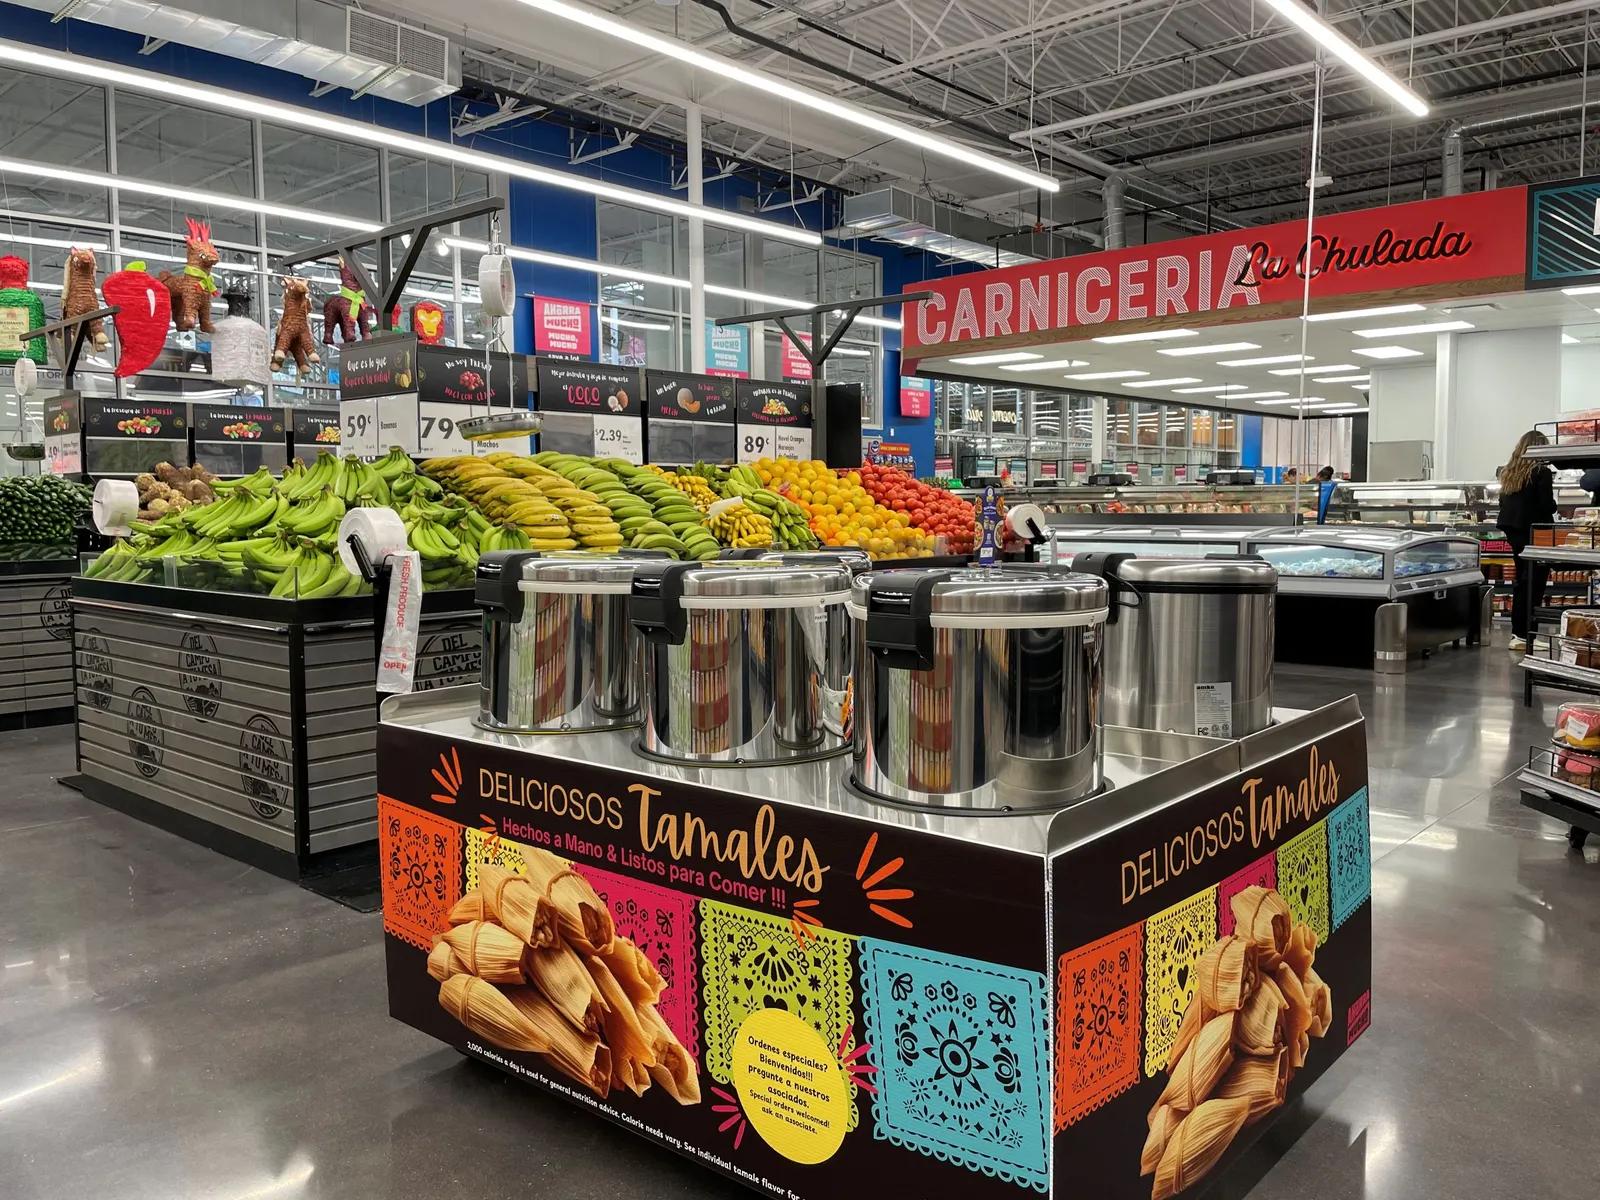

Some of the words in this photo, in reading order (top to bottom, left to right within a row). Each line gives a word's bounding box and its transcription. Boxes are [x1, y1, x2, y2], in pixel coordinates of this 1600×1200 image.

[1233, 241, 1290, 287] La
[1296, 221, 1472, 279] Chulada
[544, 303, 581, 315] AHORRA
[917, 244, 1261, 345] CARNICERIA
[546, 318, 580, 329] MUCHO
[548, 332, 578, 343] MUCHO,
[549, 340, 578, 350] MUCHO
[713, 340, 740, 350] MUCHO
[715, 360, 738, 368] MUCHO
[567, 385, 601, 405] COCO
[476, 440, 499, 448] Machos
[595, 428, 622, 441] $2.39
[402, 556, 412, 583] FRESH
[396, 584, 409, 629] PRODUCE
[480, 768, 623, 830] DELICIOSOS
[627, 783, 831, 893] Tamales
[1121, 805, 1245, 905] DELICIOSOS
[1241, 744, 1341, 849] Tamales
[502, 816, 551, 845] Hechos
[554, 834, 562, 848] a
[565, 832, 603, 859] Mano
[606, 844, 617, 863] &
[621, 847, 666, 876] Listos
[669, 864, 705, 888] para
[709, 870, 767, 904] Comer
[748, 1035, 780, 1055] Ordenes
[782, 1050, 828, 1073] especiales?
[759, 1053, 813, 1082] Bienvenidos!!!
[748, 1064, 783, 1084] pregunte
[794, 1082, 830, 1102] nuestros
[767, 1086, 810, 1109] asociados.
[466, 1041, 483, 1054] 2,000
[483, 1048, 504, 1064] calories
[509, 1061, 520, 1073] day
[520, 1065, 526, 1074] is
[526, 1069, 539, 1080] used
[539, 1074, 549, 1085] for
[549, 1080, 571, 1096] general
[571, 1089, 598, 1108] nutrition
[598, 1102, 620, 1119] advice.
[621, 1112, 644, 1130] Calorie
[645, 1125, 664, 1139] needs
[664, 1134, 682, 1149] vary.
[684, 1141, 696, 1154] See
[697, 1147, 732, 1171] individual
[733, 1165, 760, 1184] tamale
[761, 1177, 786, 1196] flavor
[749, 1089, 772, 1104] Special
[773, 1100, 794, 1114] orders
[796, 1110, 830, 1128] welcomed!
[761, 1106, 773, 1116] ask
[775, 1112, 784, 1120] an
[785, 1115, 818, 1135] associate.
